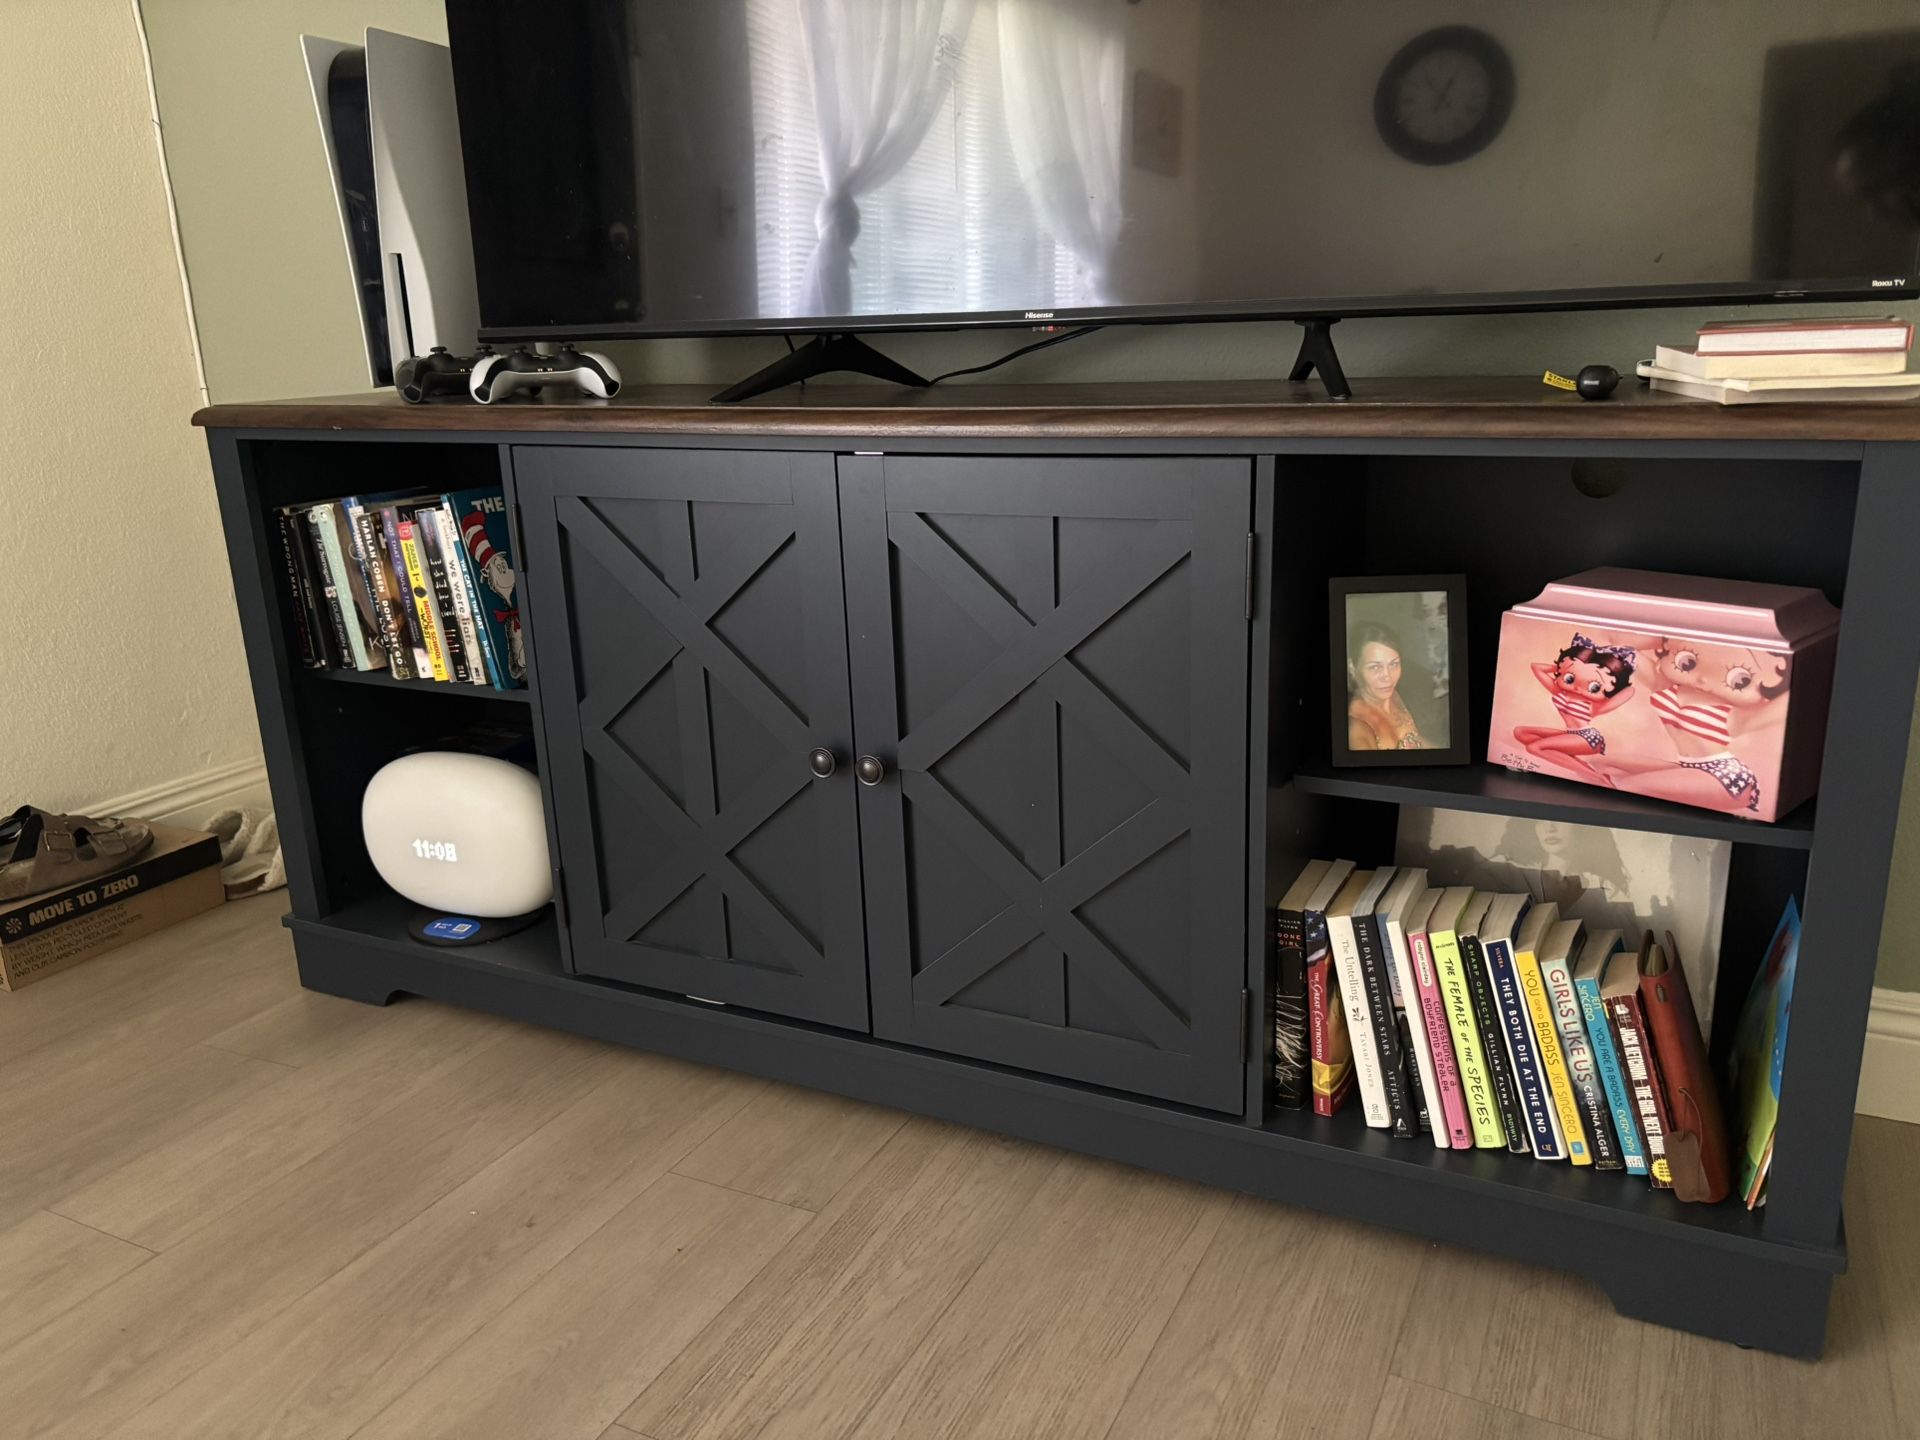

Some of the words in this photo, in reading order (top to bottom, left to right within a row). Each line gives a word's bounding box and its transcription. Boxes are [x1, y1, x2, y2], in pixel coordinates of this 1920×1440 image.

[1894, 279, 1905, 287] TV
[471, 496, 504, 514] THE
[283, 538, 295, 575] WRONG
[290, 576, 299, 598] MAN
[361, 520, 376, 559] HARLAN
[372, 561, 384, 593] COBEN
[387, 521, 395, 537] NOT
[392, 540, 400, 559] THAT
[398, 566, 408, 593] COULD
[405, 596, 413, 613] TELL
[461, 560, 469, 574] THE
[464, 575, 473, 589] CAT
[448, 560, 458, 578] we
[453, 583, 466, 614] were
[461, 617, 472, 646] liars
[472, 601, 480, 616] THE
[382, 600, 396, 629] DON'T
[390, 631, 399, 648] LET
[395, 651, 403, 665] GO
[423, 600, 434, 631] MIDDLE
[431, 631, 440, 661] SCHOOL
[476, 616, 485, 631] HAT
[412, 839, 457, 862] 11:08
[28, 898, 75, 926] MOVE
[76, 890, 98, 907] TO
[101, 874, 139, 899] ZERO
[1277, 932, 1301, 940] GONE
[1359, 923, 1368, 943] THE
[1363, 947, 1375, 973] DARK
[1444, 957, 1455, 976] THE
[1494, 947, 1504, 968] SILVERA
[1344, 956, 1360, 1002] Untelling
[1467, 944, 1479, 976] SHARP
[1476, 981, 1491, 1025] OBJECTS
[1501, 977, 1515, 1004] THEY
[1312, 983, 1323, 1009] GREAT
[1369, 976, 1385, 1022] BETWEEN
[1448, 981, 1469, 1027] FEMALE
[1550, 969, 1576, 1017] GIRLS
[1578, 985, 1595, 1021] SINCERO
[1509, 1010, 1523, 1039] BOTH
[1523, 970, 1540, 996] YOU
[1537, 1021, 1560, 1066] BADASS
[1313, 1010, 1324, 1060] CONTROVERSY
[1379, 1026, 1391, 1056] STARS
[1461, 1032, 1469, 1043] OF
[1563, 1021, 1586, 1056] LIKE
[1620, 1027, 1640, 1046] JACK
[1464, 1046, 1474, 1063] THE
[1517, 1044, 1529, 1062] DIE
[1365, 1063, 1374, 1088] JONES
[1446, 1065, 1455, 1077] OF
[1488, 1033, 1501, 1071] GILLIAN
[1498, 1076, 1509, 1106] FLYNN
[1522, 1068, 1534, 1081] AT
[1573, 1059, 1593, 1083] US
[1387, 1069, 1400, 1110] ATTICUS
[1467, 1067, 1490, 1125] SPECIES
[1528, 1087, 1540, 1107] THE
[1595, 1028, 1607, 1046] YOU
[1601, 1049, 1613, 1064] ARE
[1607, 1074, 1622, 1107] BADASS
[1616, 1109, 1629, 1133] EVERY
[1624, 1136, 1636, 1152] DAY
[1635, 1085, 1653, 1099] THE
[1638, 1100, 1657, 1115] GIRL
[1534, 1112, 1547, 1134] END
[1583, 1085, 1601, 1126] CRISTINA
[1595, 1129, 1609, 1157] ALGER
